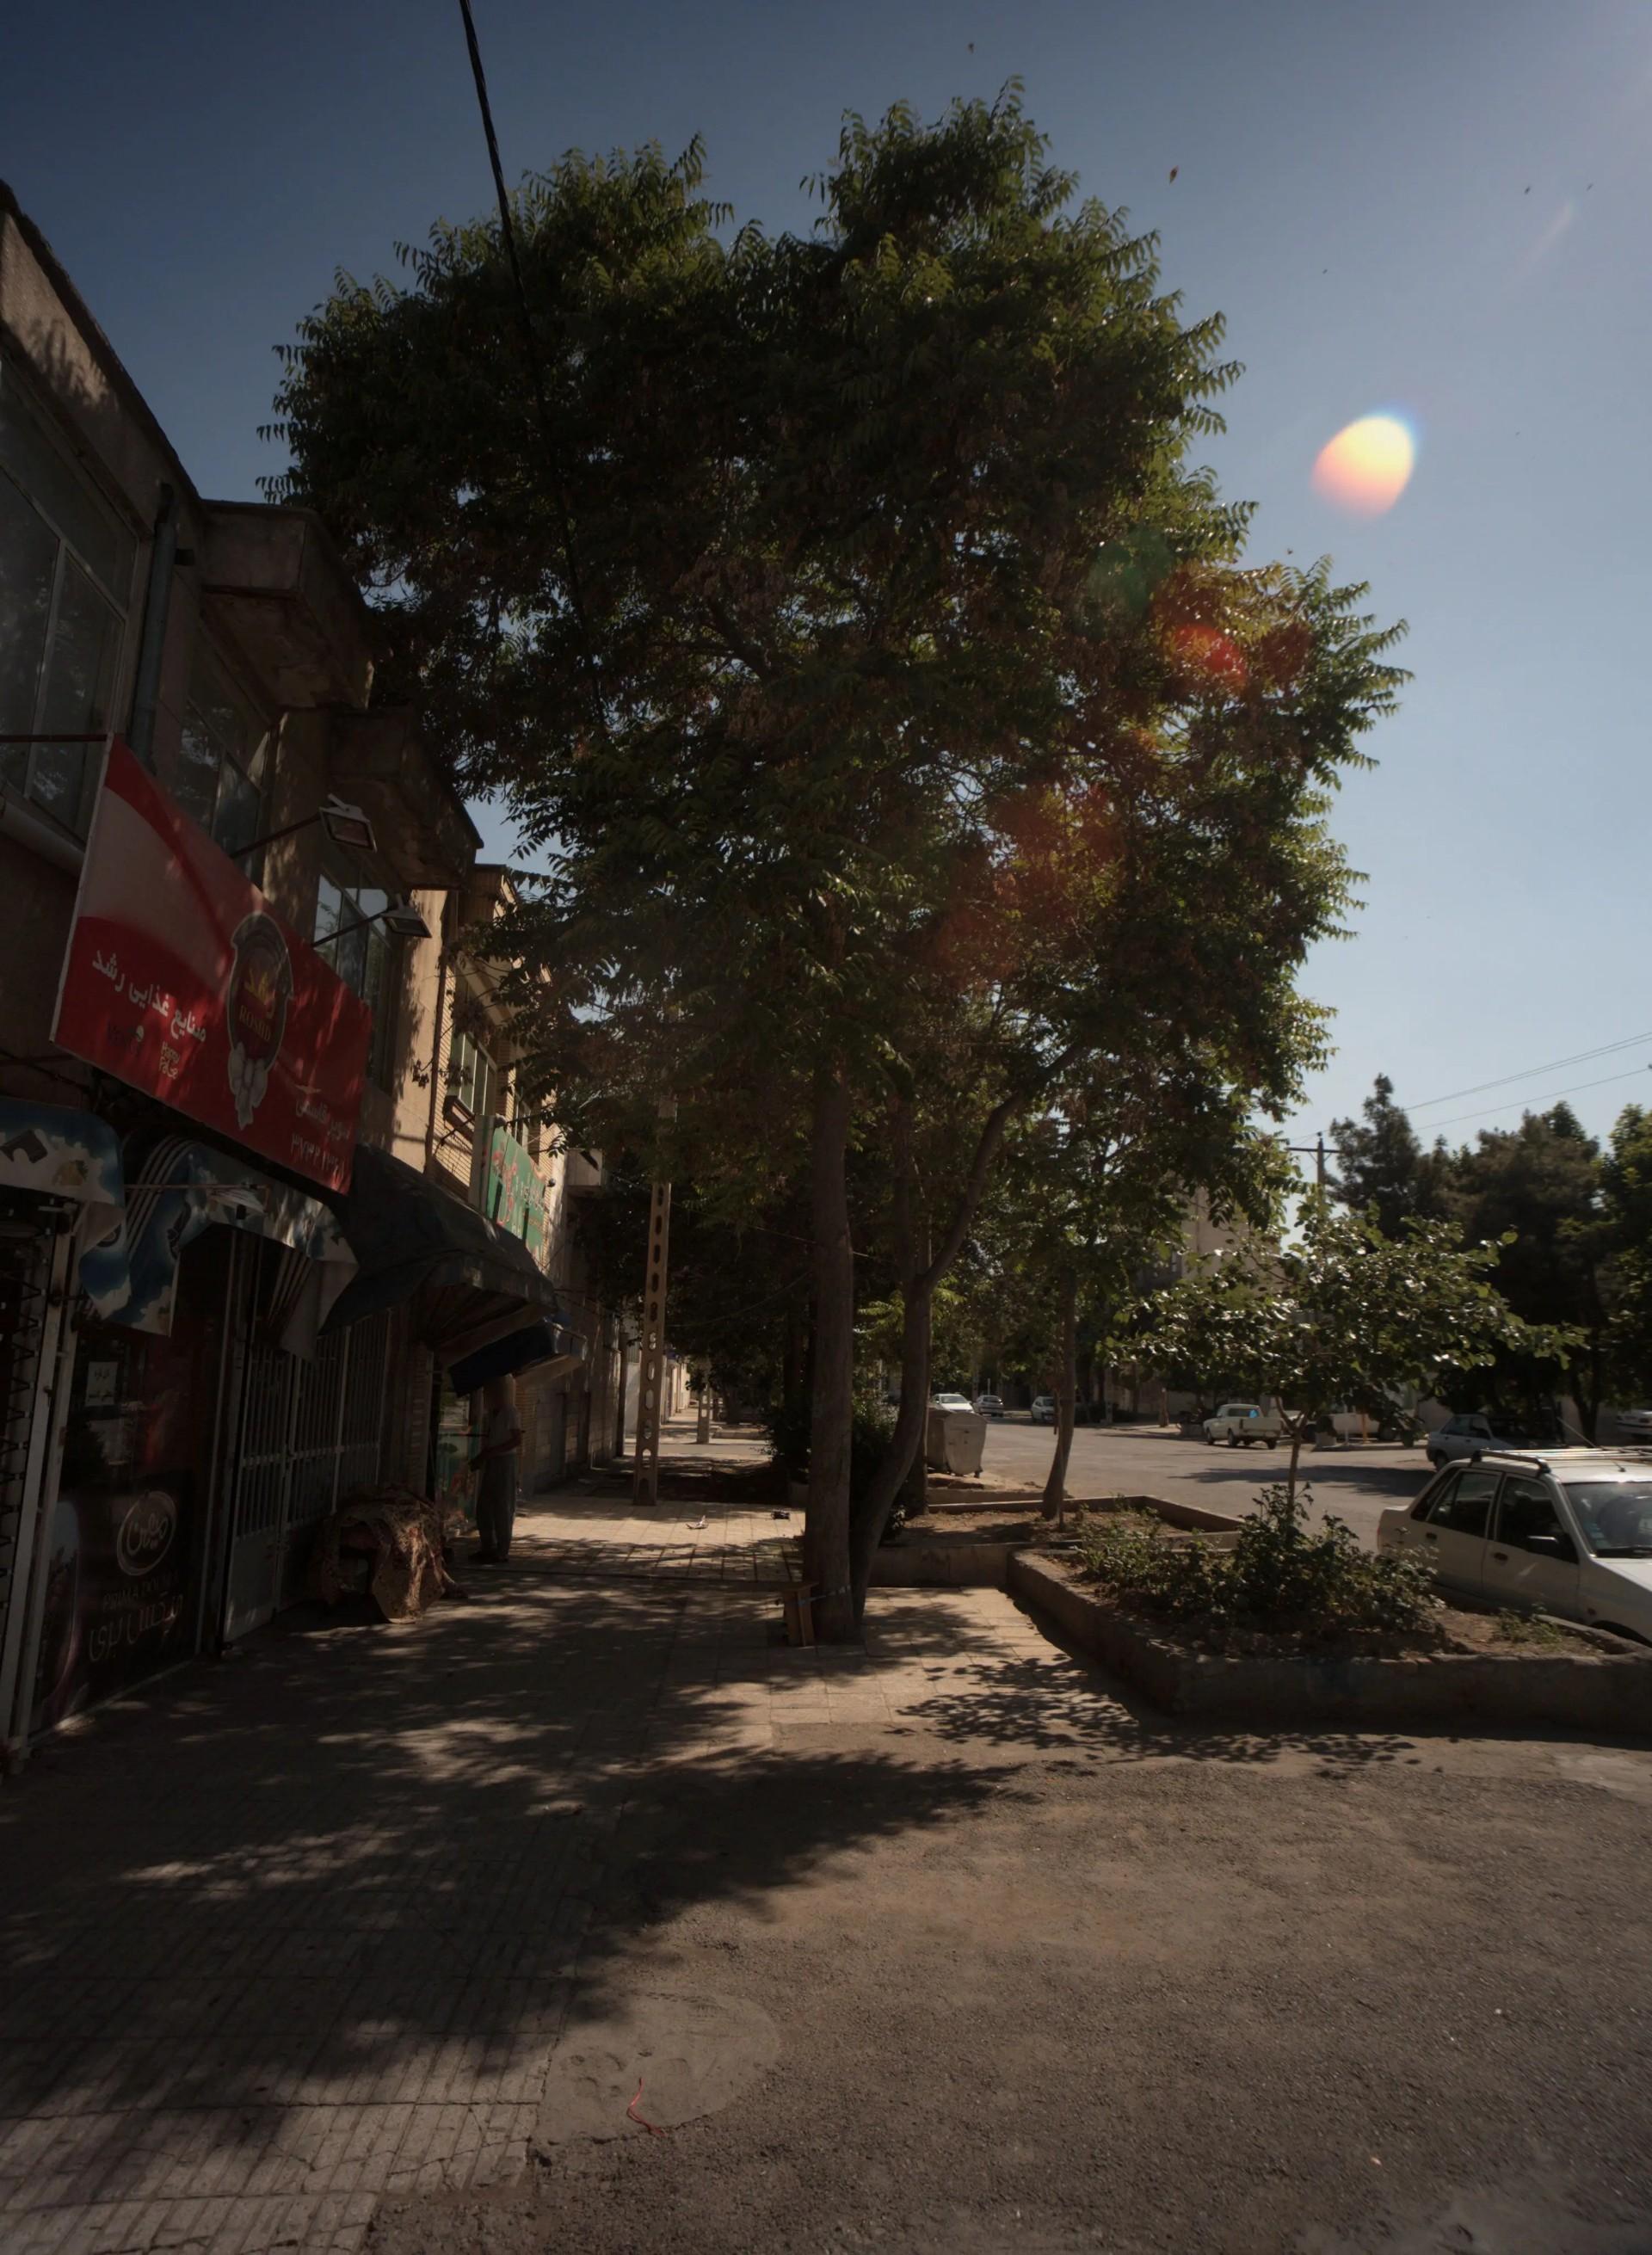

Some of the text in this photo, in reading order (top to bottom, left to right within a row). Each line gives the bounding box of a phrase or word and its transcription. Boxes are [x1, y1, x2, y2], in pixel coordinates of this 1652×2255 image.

[91, 950, 126, 992] رشد
[129, 983, 170, 1018] غذایی
[170, 1009, 206, 1043] صنایع
